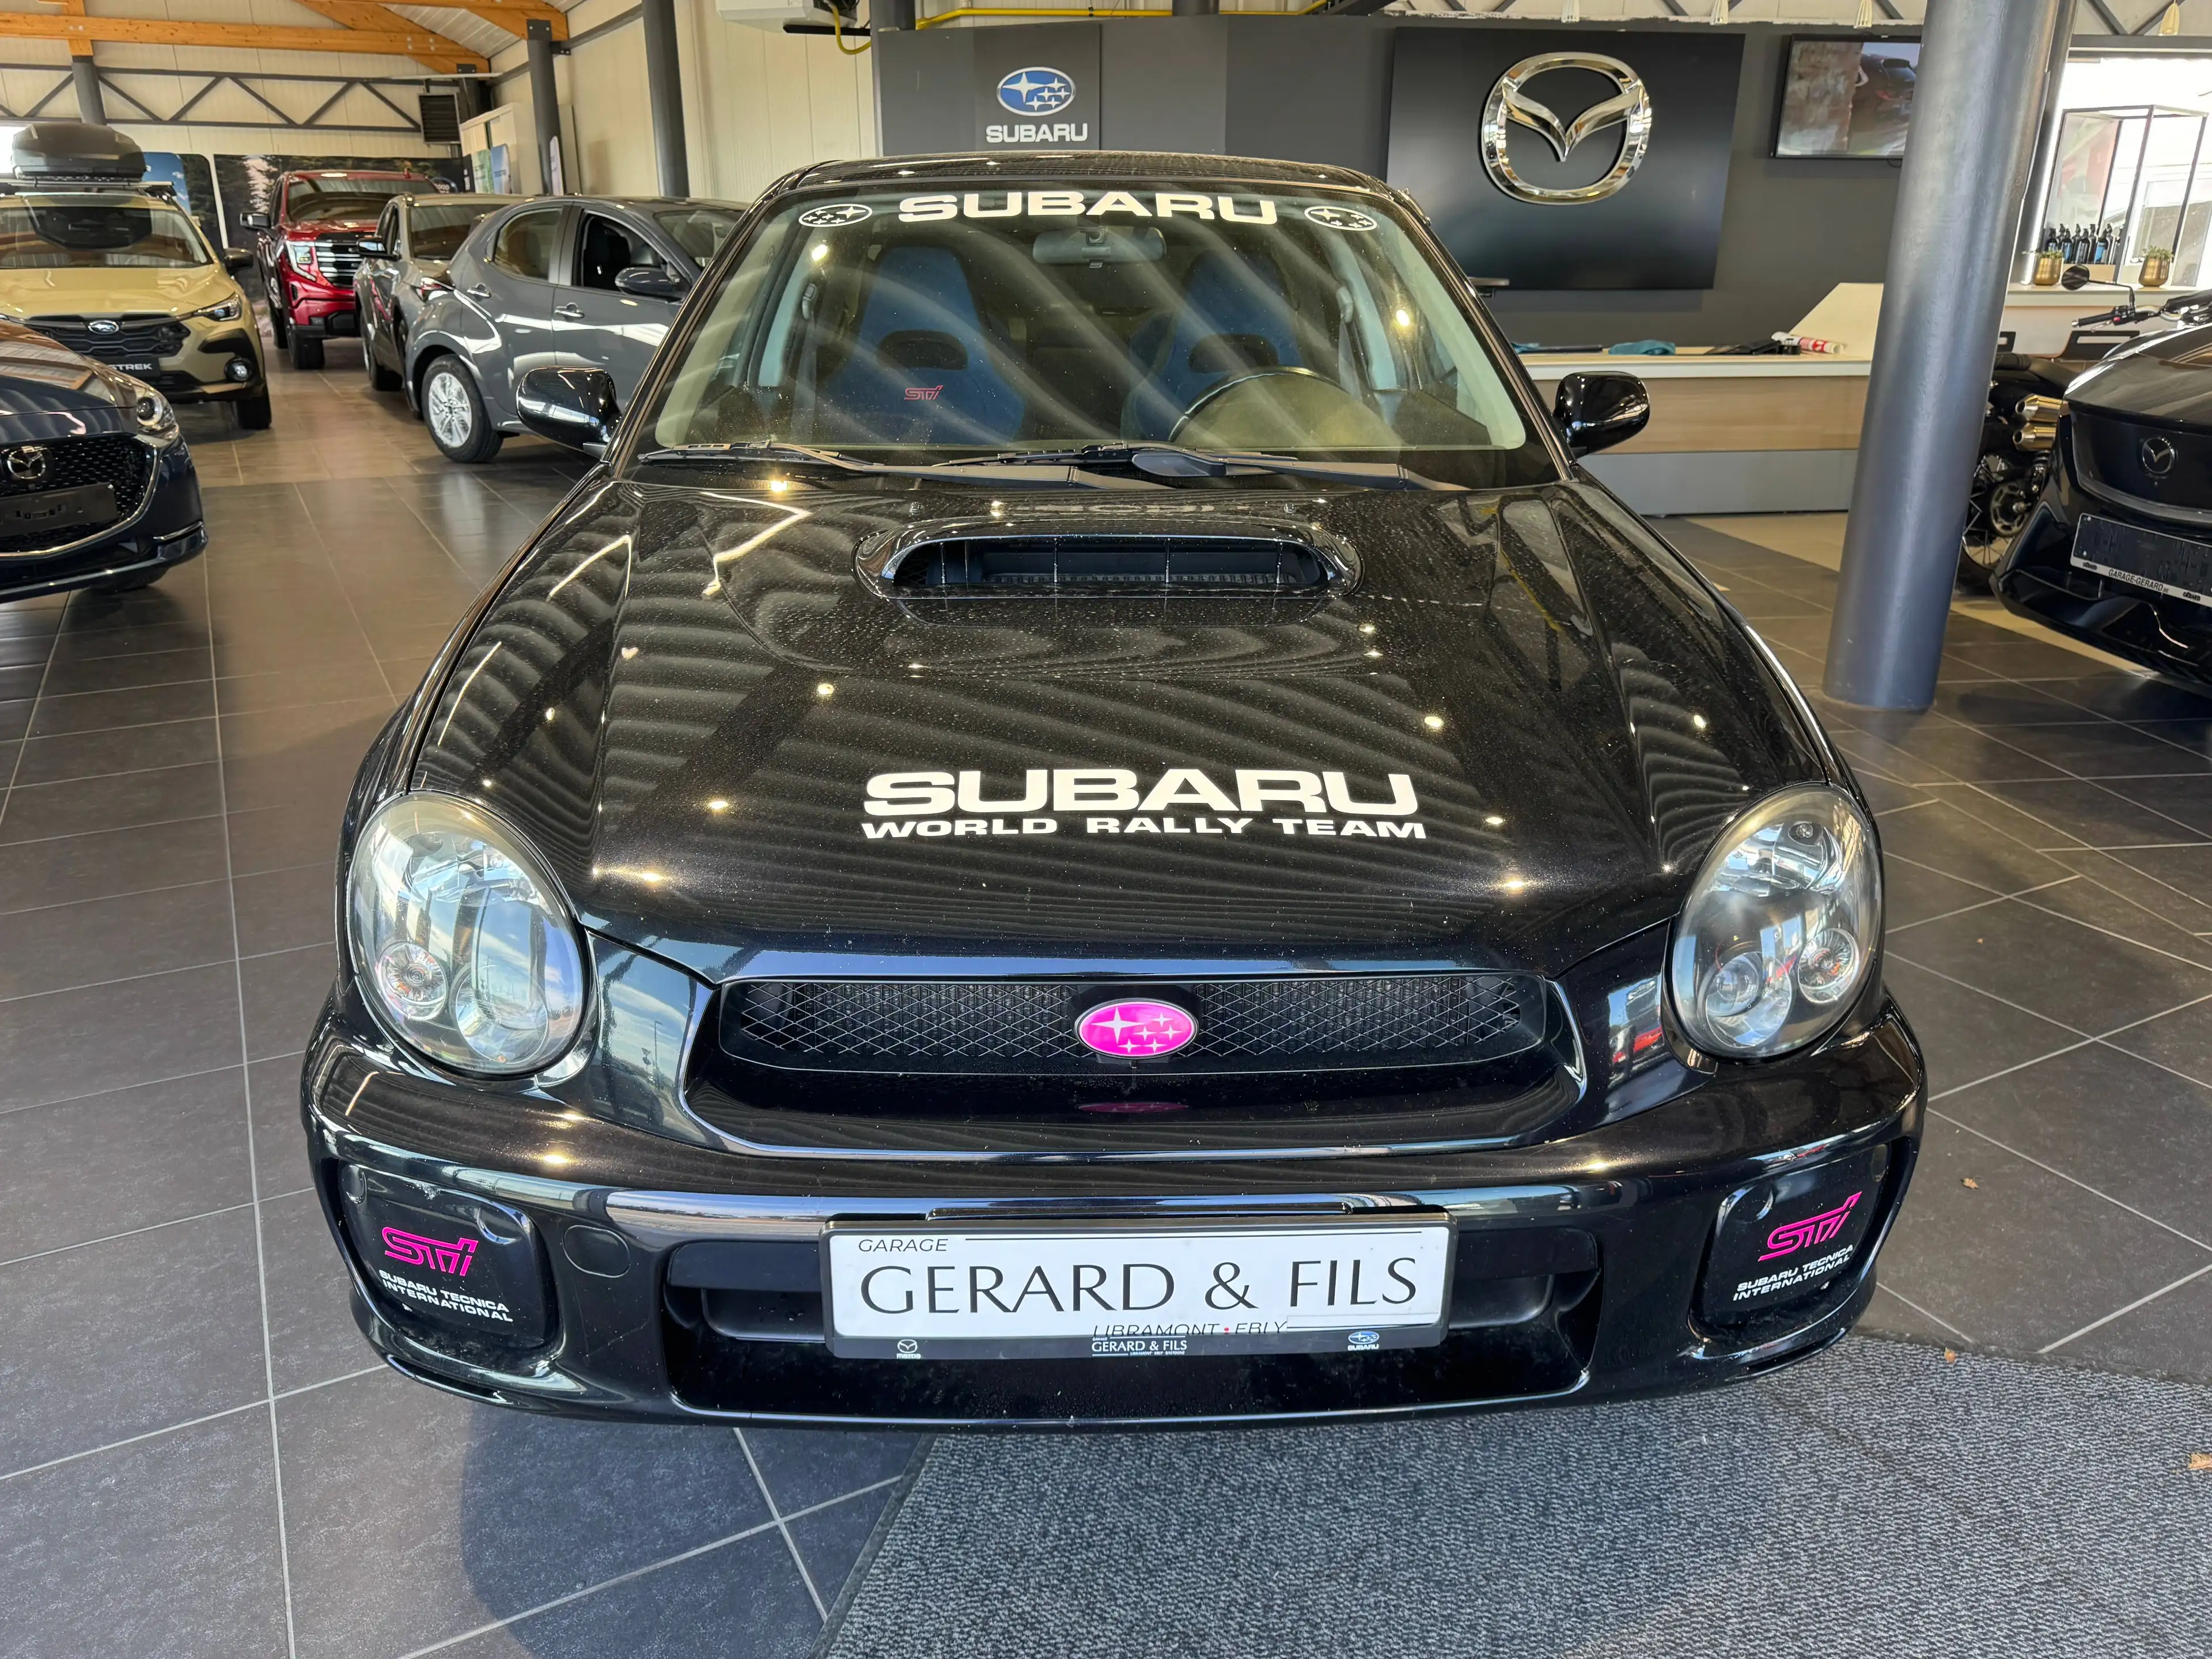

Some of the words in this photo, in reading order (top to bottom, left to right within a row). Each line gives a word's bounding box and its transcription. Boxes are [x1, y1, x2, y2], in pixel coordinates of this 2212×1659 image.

[986, 123, 1088, 143] SUBARU
[898, 191, 1278, 225] SUBARU
[863, 769, 1418, 816] SUBARU
[861, 819, 1058, 839] WORLD
[1087, 817, 1253, 834] RALLY
[1272, 819, 1426, 839] TEAM
[858, 1238, 948, 1252] GARAGE
[861, 1264, 1174, 1314] GERARD
[1205, 1263, 1257, 1310] &
[1290, 1257, 1416, 1308] FILS
[1733, 1255, 1850, 1301] INTERNATIONAL
[1737, 1267, 1798, 1291] SUBARU
[1802, 1244, 1853, 1271] TECNICA
[378, 1270, 437, 1296] SUBARU
[440, 1289, 510, 1313] TECNICA
[382, 1279, 514, 1323] INTERNATIONAL
[1091, 1340, 1146, 1353] GERARD
[1149, 1340, 1159, 1351] &
[1163, 1339, 1187, 1351] FILS
[1347, 1343, 1380, 1351] SUBARU
